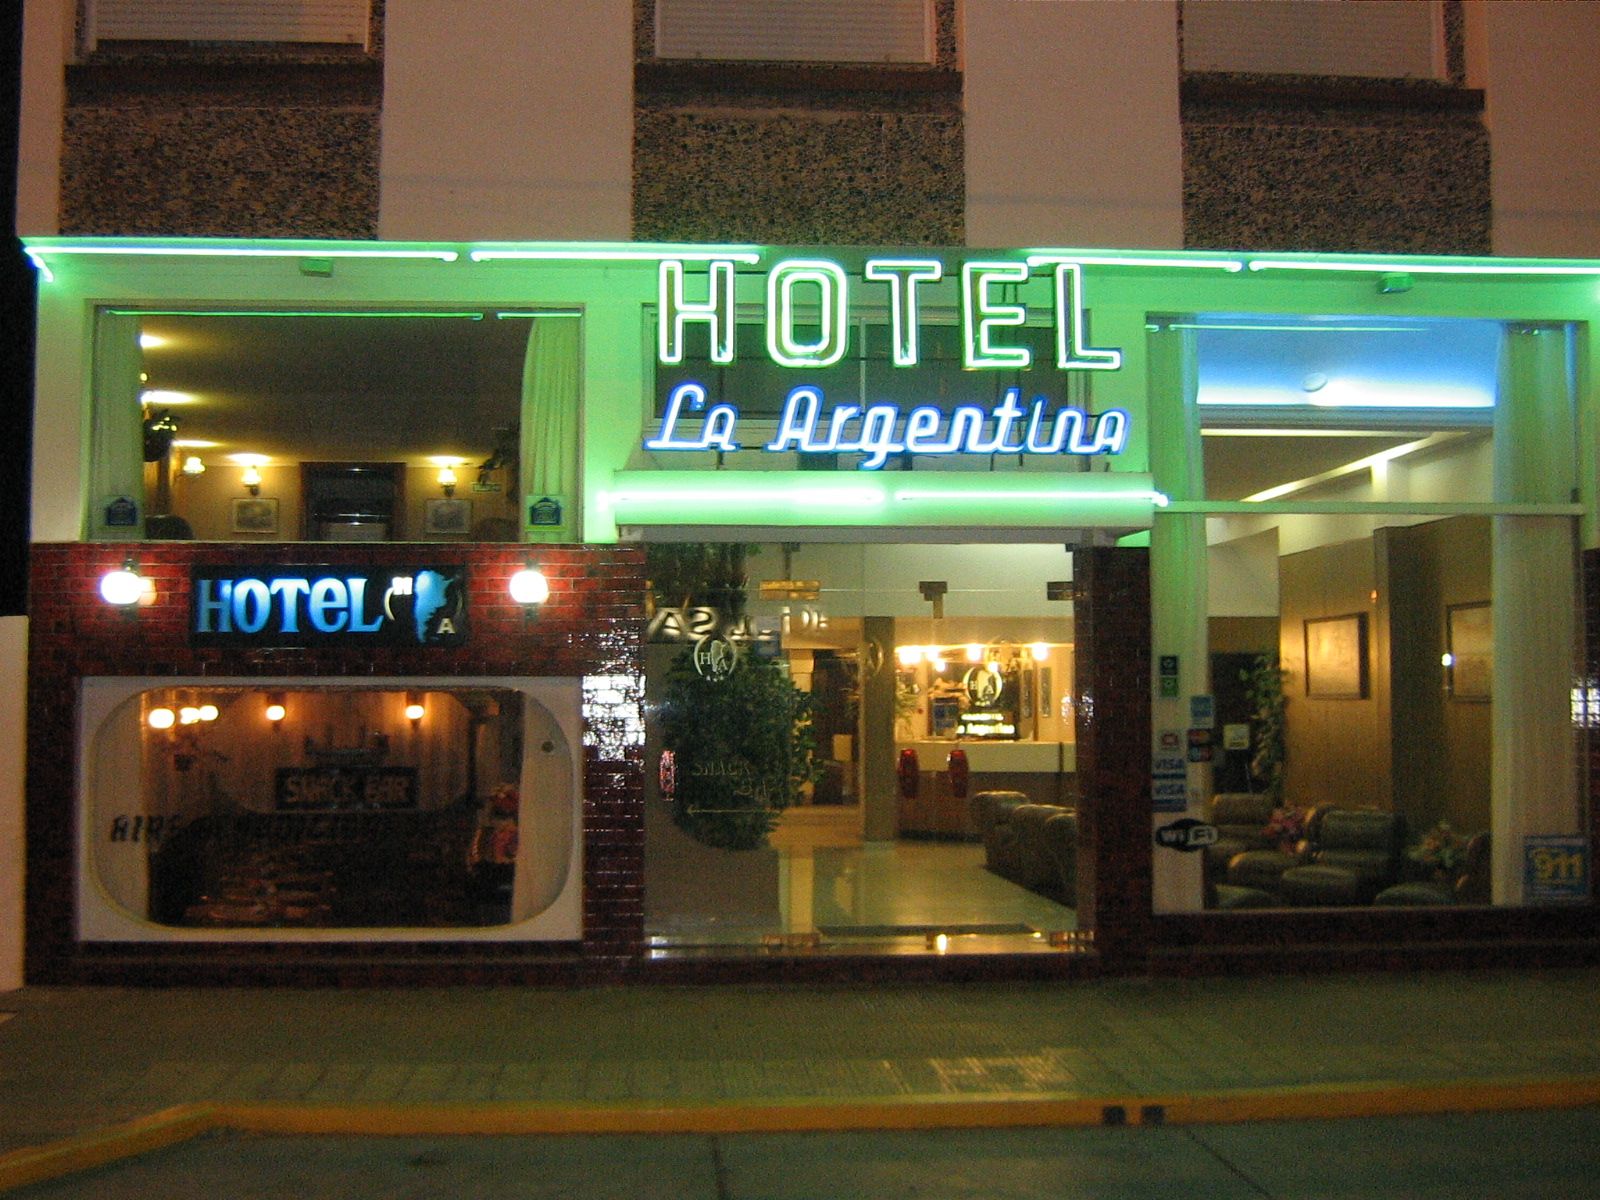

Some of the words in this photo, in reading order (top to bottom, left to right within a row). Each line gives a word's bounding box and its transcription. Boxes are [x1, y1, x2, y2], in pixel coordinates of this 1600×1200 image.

[658, 259, 1122, 370] HOTEL
[644, 382, 738, 451] La
[767, 384, 1128, 470] Argentina
